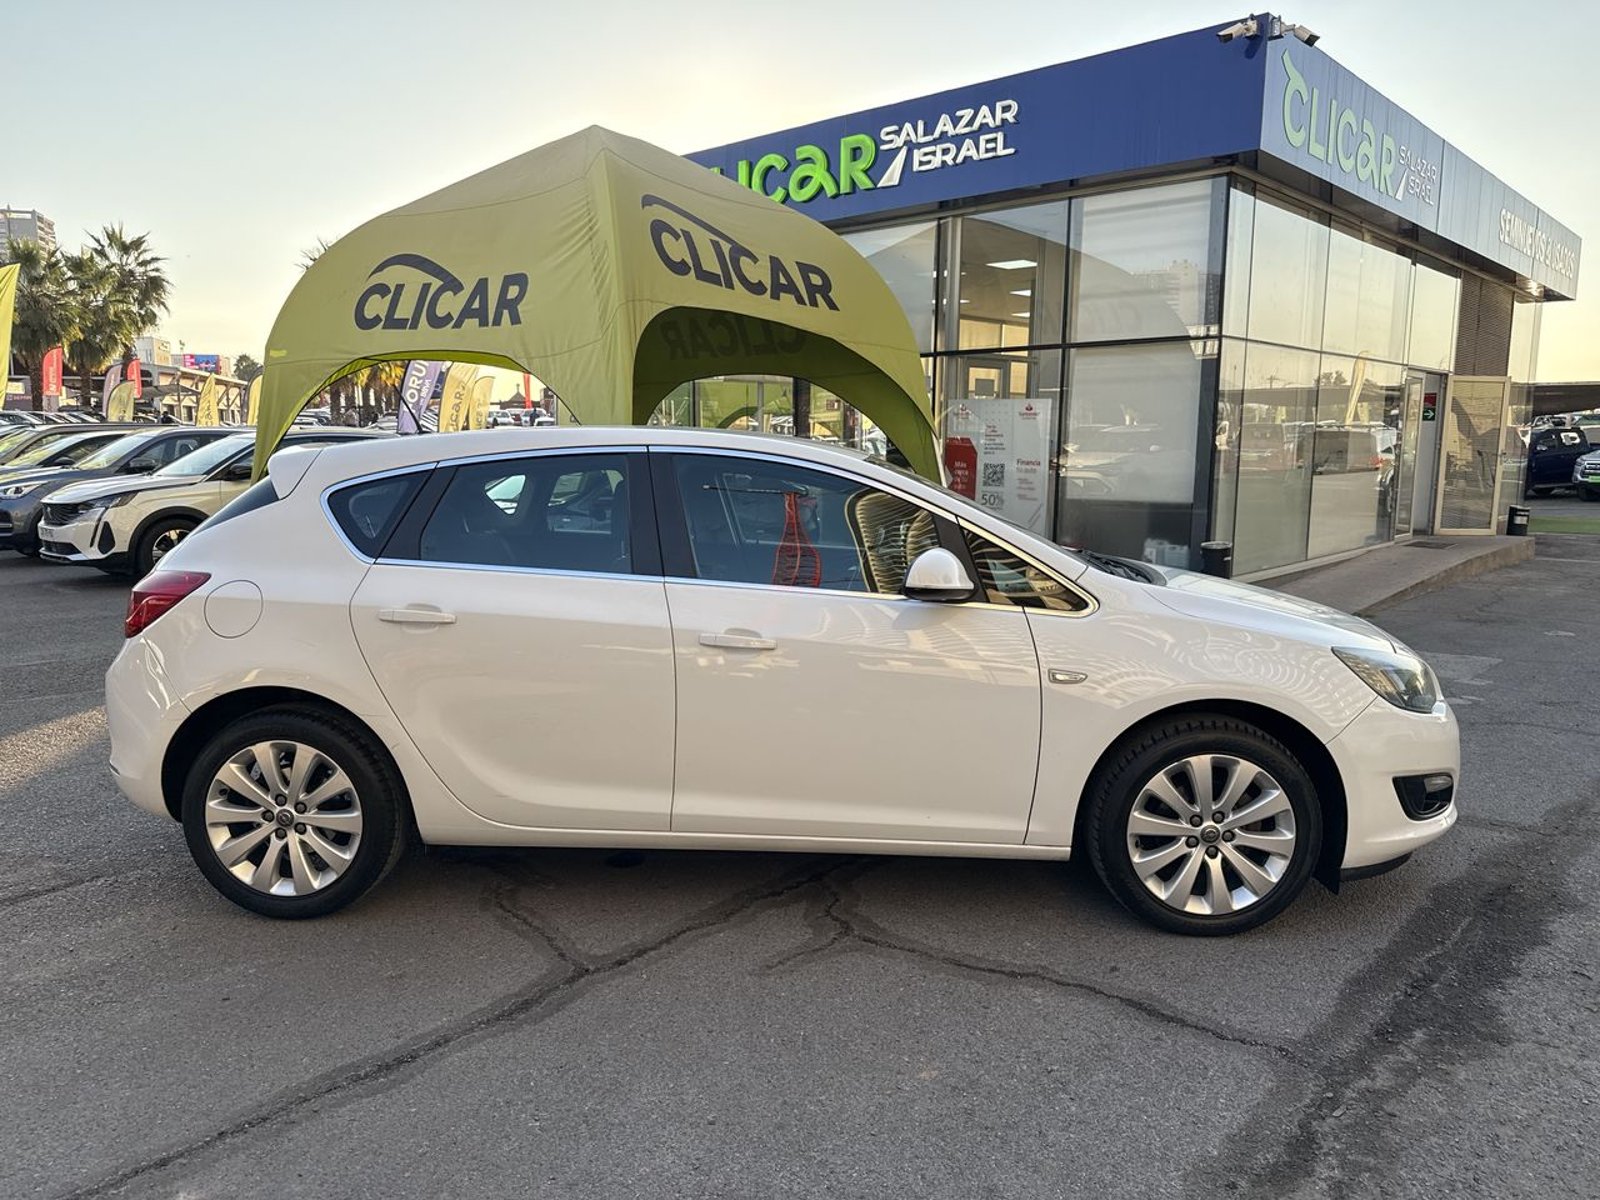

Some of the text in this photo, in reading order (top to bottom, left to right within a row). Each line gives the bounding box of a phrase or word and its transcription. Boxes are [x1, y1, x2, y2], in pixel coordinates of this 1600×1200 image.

[880, 99, 1018, 151] SALAZAR
[912, 132, 1015, 172] ISRAEL
[648, 218, 840, 312] CLICAR
[354, 271, 529, 331] CLICAR
